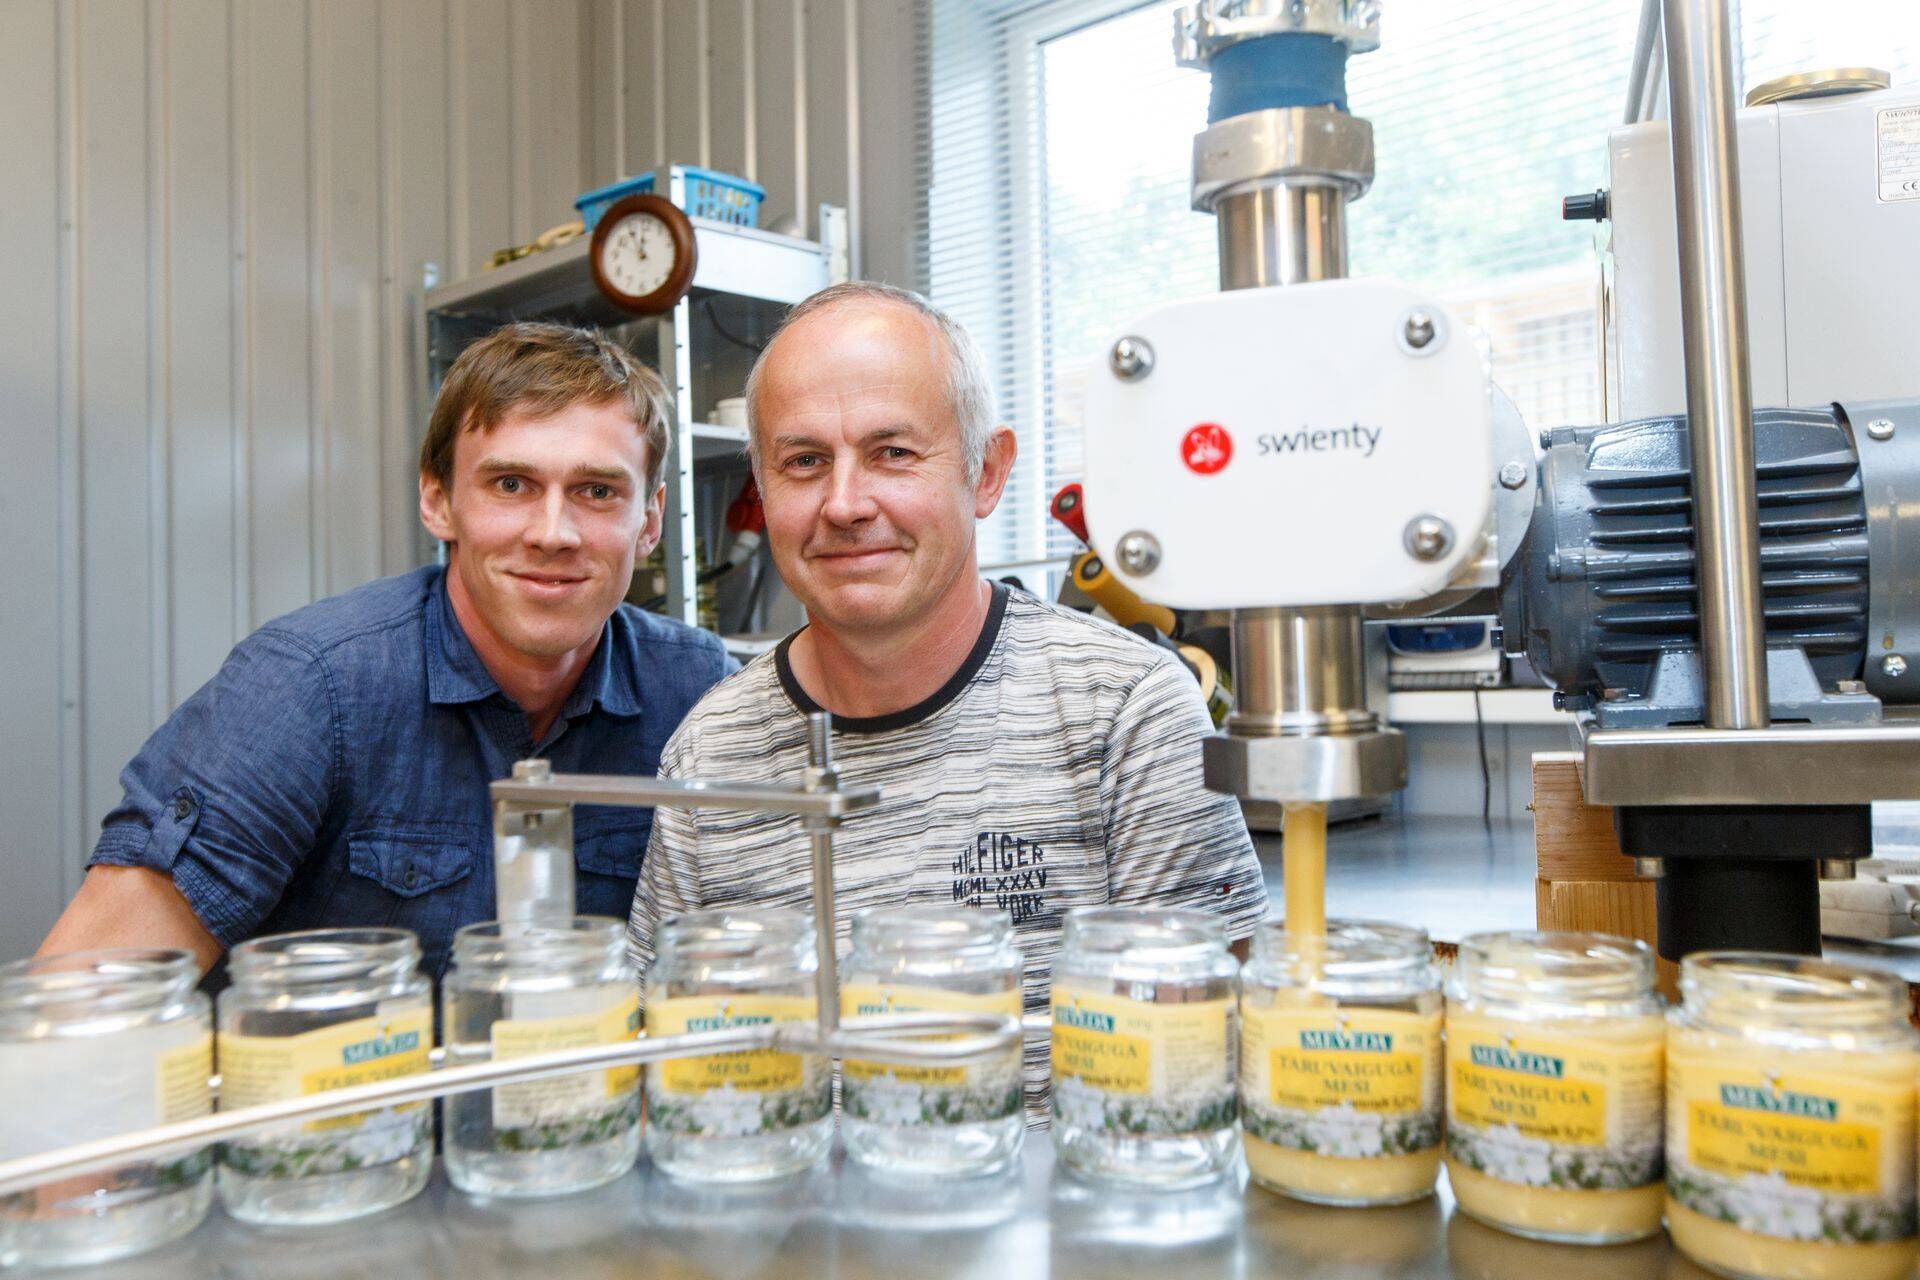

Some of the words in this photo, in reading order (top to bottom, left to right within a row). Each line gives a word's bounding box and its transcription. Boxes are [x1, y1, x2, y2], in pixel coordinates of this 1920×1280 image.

[1256, 421, 1383, 458] swienty
[952, 832, 1044, 874] HILFIGER
[953, 869, 1047, 902] MCMLXXXV
[1323, 1078, 1372, 1094] MESI
